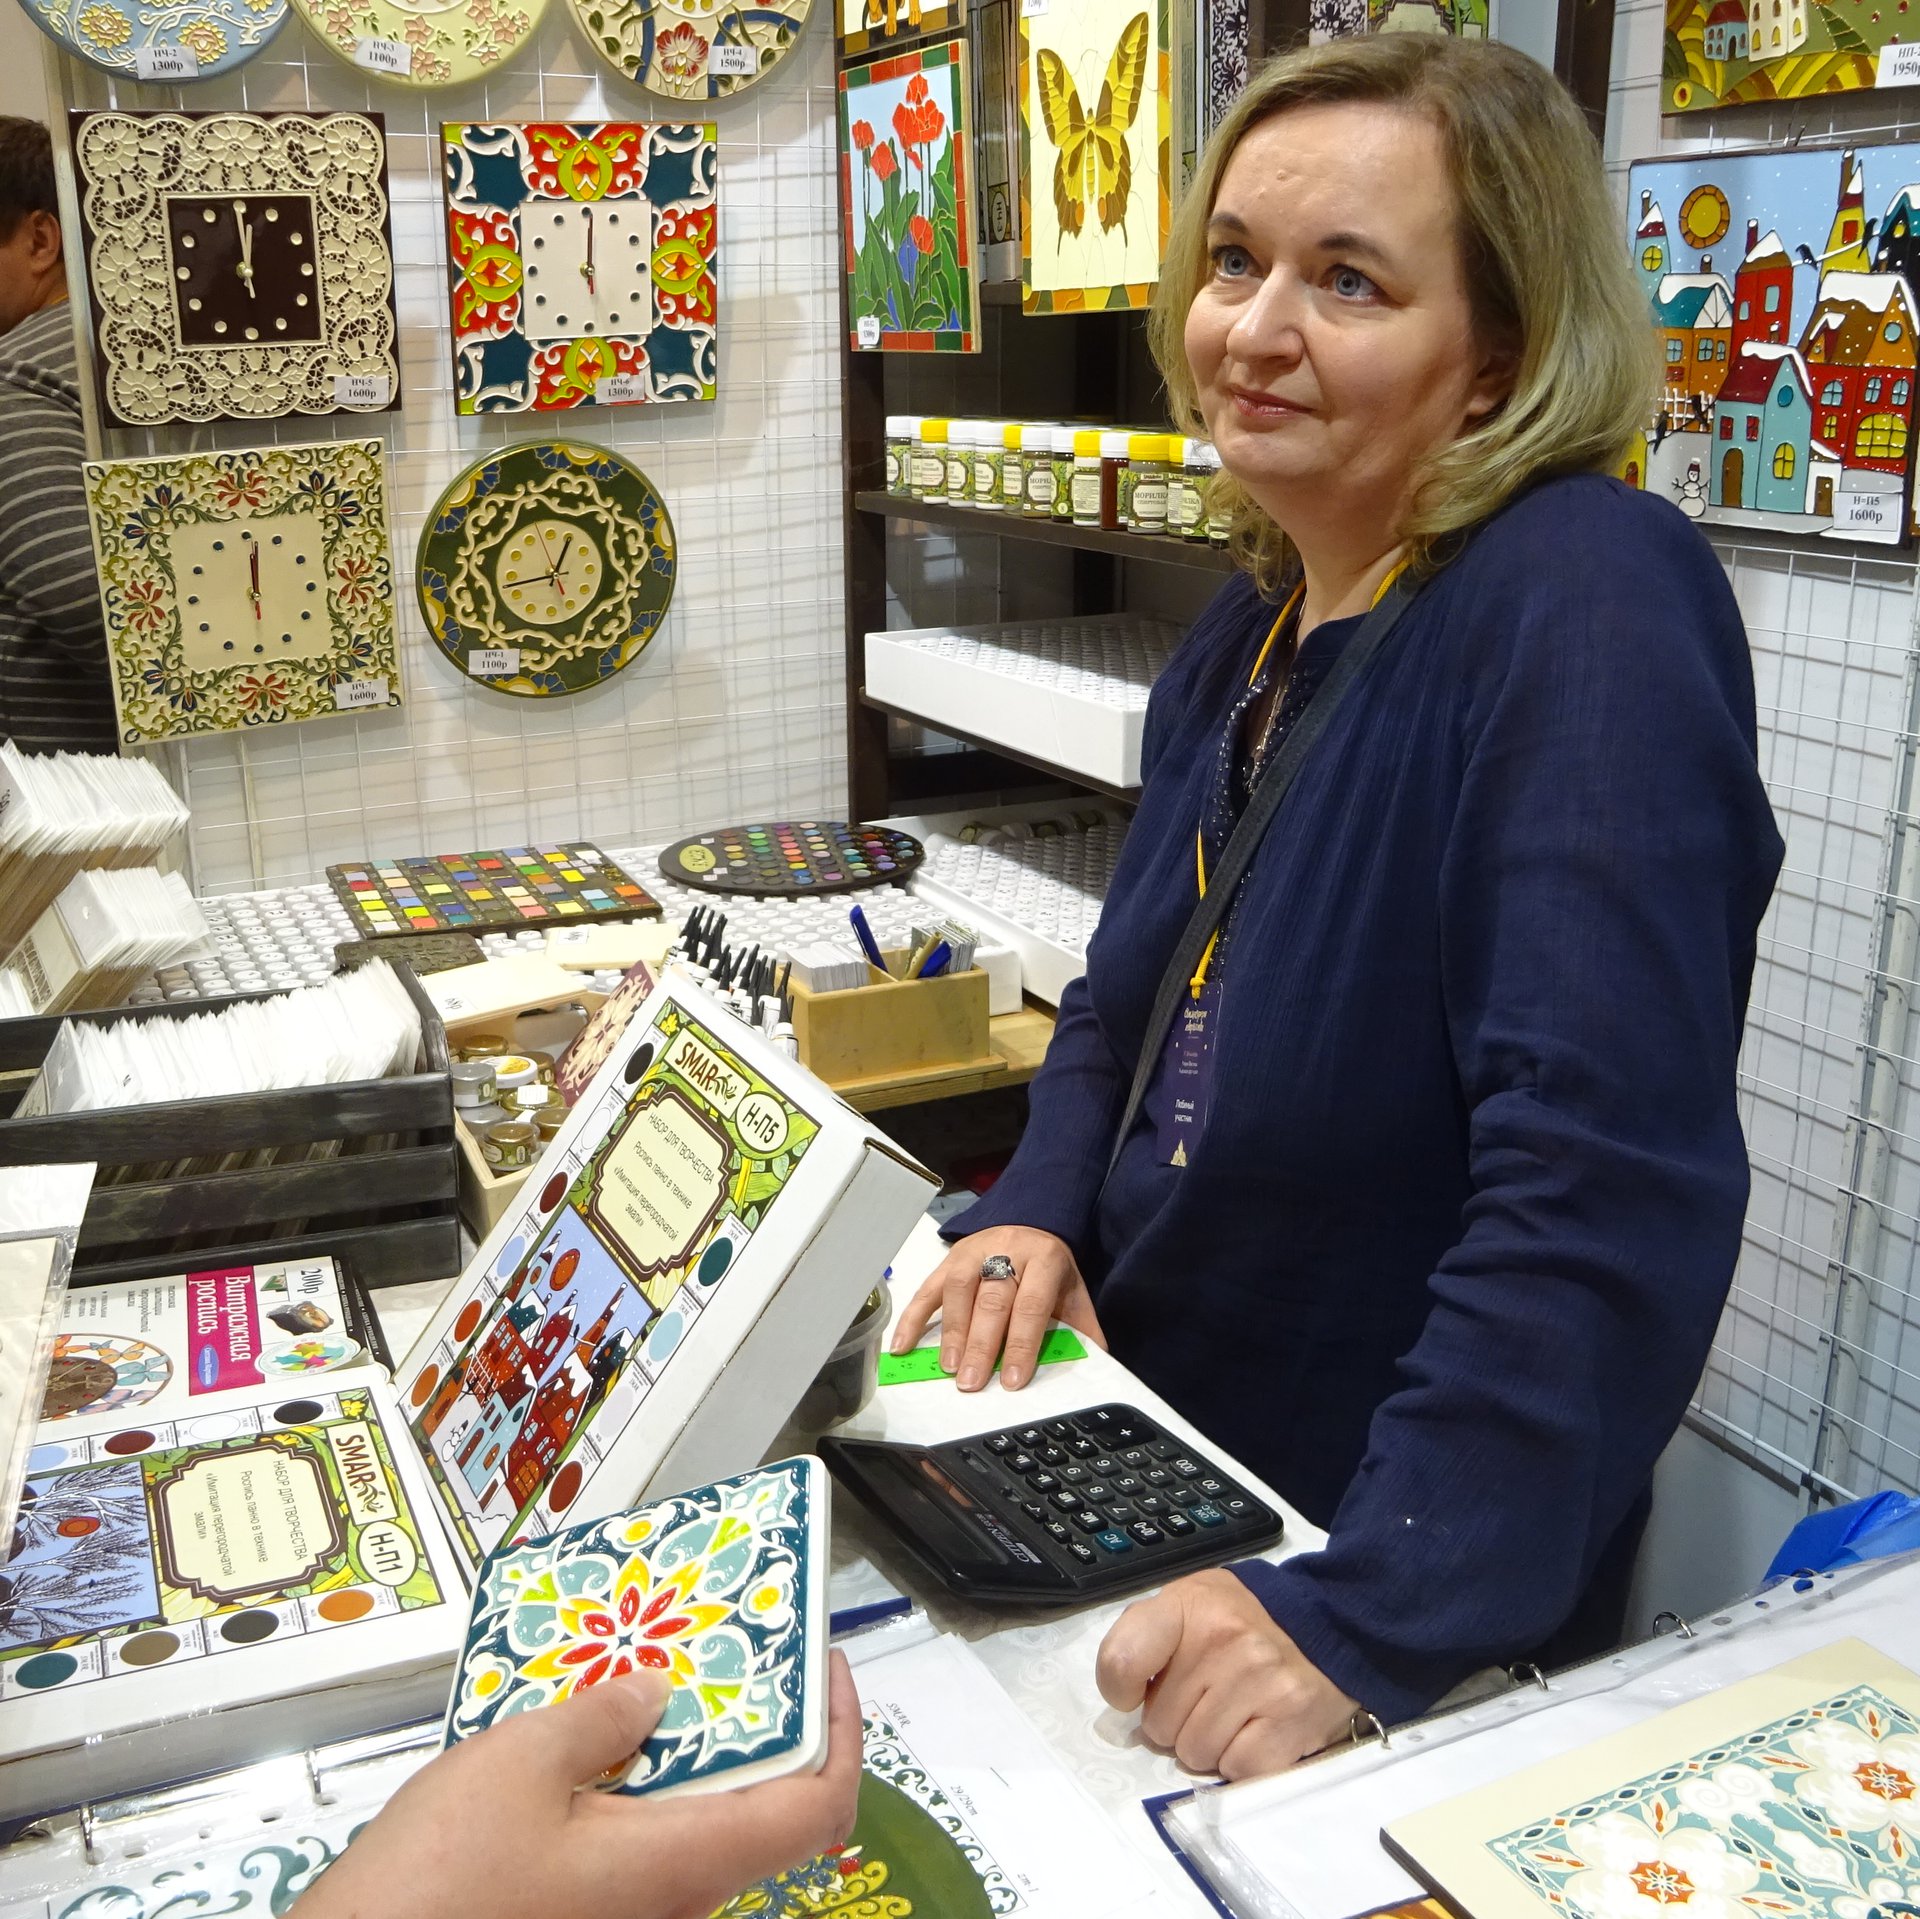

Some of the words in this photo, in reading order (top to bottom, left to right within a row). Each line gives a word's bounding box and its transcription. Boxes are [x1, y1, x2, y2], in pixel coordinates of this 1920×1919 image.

[153, 48, 178, 58] НЧ-2
[370, 51, 398, 67] 1100р
[152, 60, 184, 72] 1300р
[720, 58, 746, 70] 1500р
[351, 378, 373, 387] НЧ-5
[348, 388, 377, 400] 1600р
[607, 386, 634, 398] 1300р
[1848, 509, 1883, 525] 1600р
[481, 660, 508, 670] 1100р
[349, 690, 377, 701] 1600р
[675, 1041, 719, 1091] SMAR
[741, 1101, 780, 1145] Н-П5
[648, 1111, 669, 1136] НАБОР
[663, 1130, 681, 1149] ДЛЯ
[676, 1138, 715, 1185] ТВОРЧЕСТВА
[633, 1140, 653, 1168] Роспись
[650, 1162, 668, 1184] панно
[666, 1179, 674, 1188] в
[670, 1183, 693, 1210] технике
[635, 1191, 680, 1242] перегородчатой
[296, 1266, 324, 1295] 200р
[188, 1278, 219, 1335] роспись
[222, 1273, 252, 1363] Витражная
[335, 1434, 376, 1489] SMAR
[1127, 1451, 1141, 1459] 3
[1096, 1459, 1110, 1467] 6
[1176, 1459, 1197, 1473] 000
[273, 1459, 288, 1487] НАБОР
[1067, 1467, 1081, 1475] 9
[1150, 1470, 1164, 1478] 2
[240, 1470, 254, 1501] Роспись
[1120, 1477, 1134, 1486] 5
[1202, 1479, 1220, 1490] 00
[277, 1487, 293, 1504] ДЛЯ
[1090, 1486, 1103, 1494] 8
[246, 1500, 259, 1524] панно
[1112, 1506, 1127, 1514] 7
[1230, 1500, 1243, 1509] 0
[283, 1503, 308, 1561] ТВОРЧЕСТВА
[1104, 1534, 1122, 1545] AC
[212, 1511, 236, 1577] перегородчатой
[251, 1533, 269, 1563] технике
[991, 1528, 1031, 1563] CITIZEN
[1073, 1543, 1091, 1556] OFF
[368, 1531, 403, 1574] Н-П1
